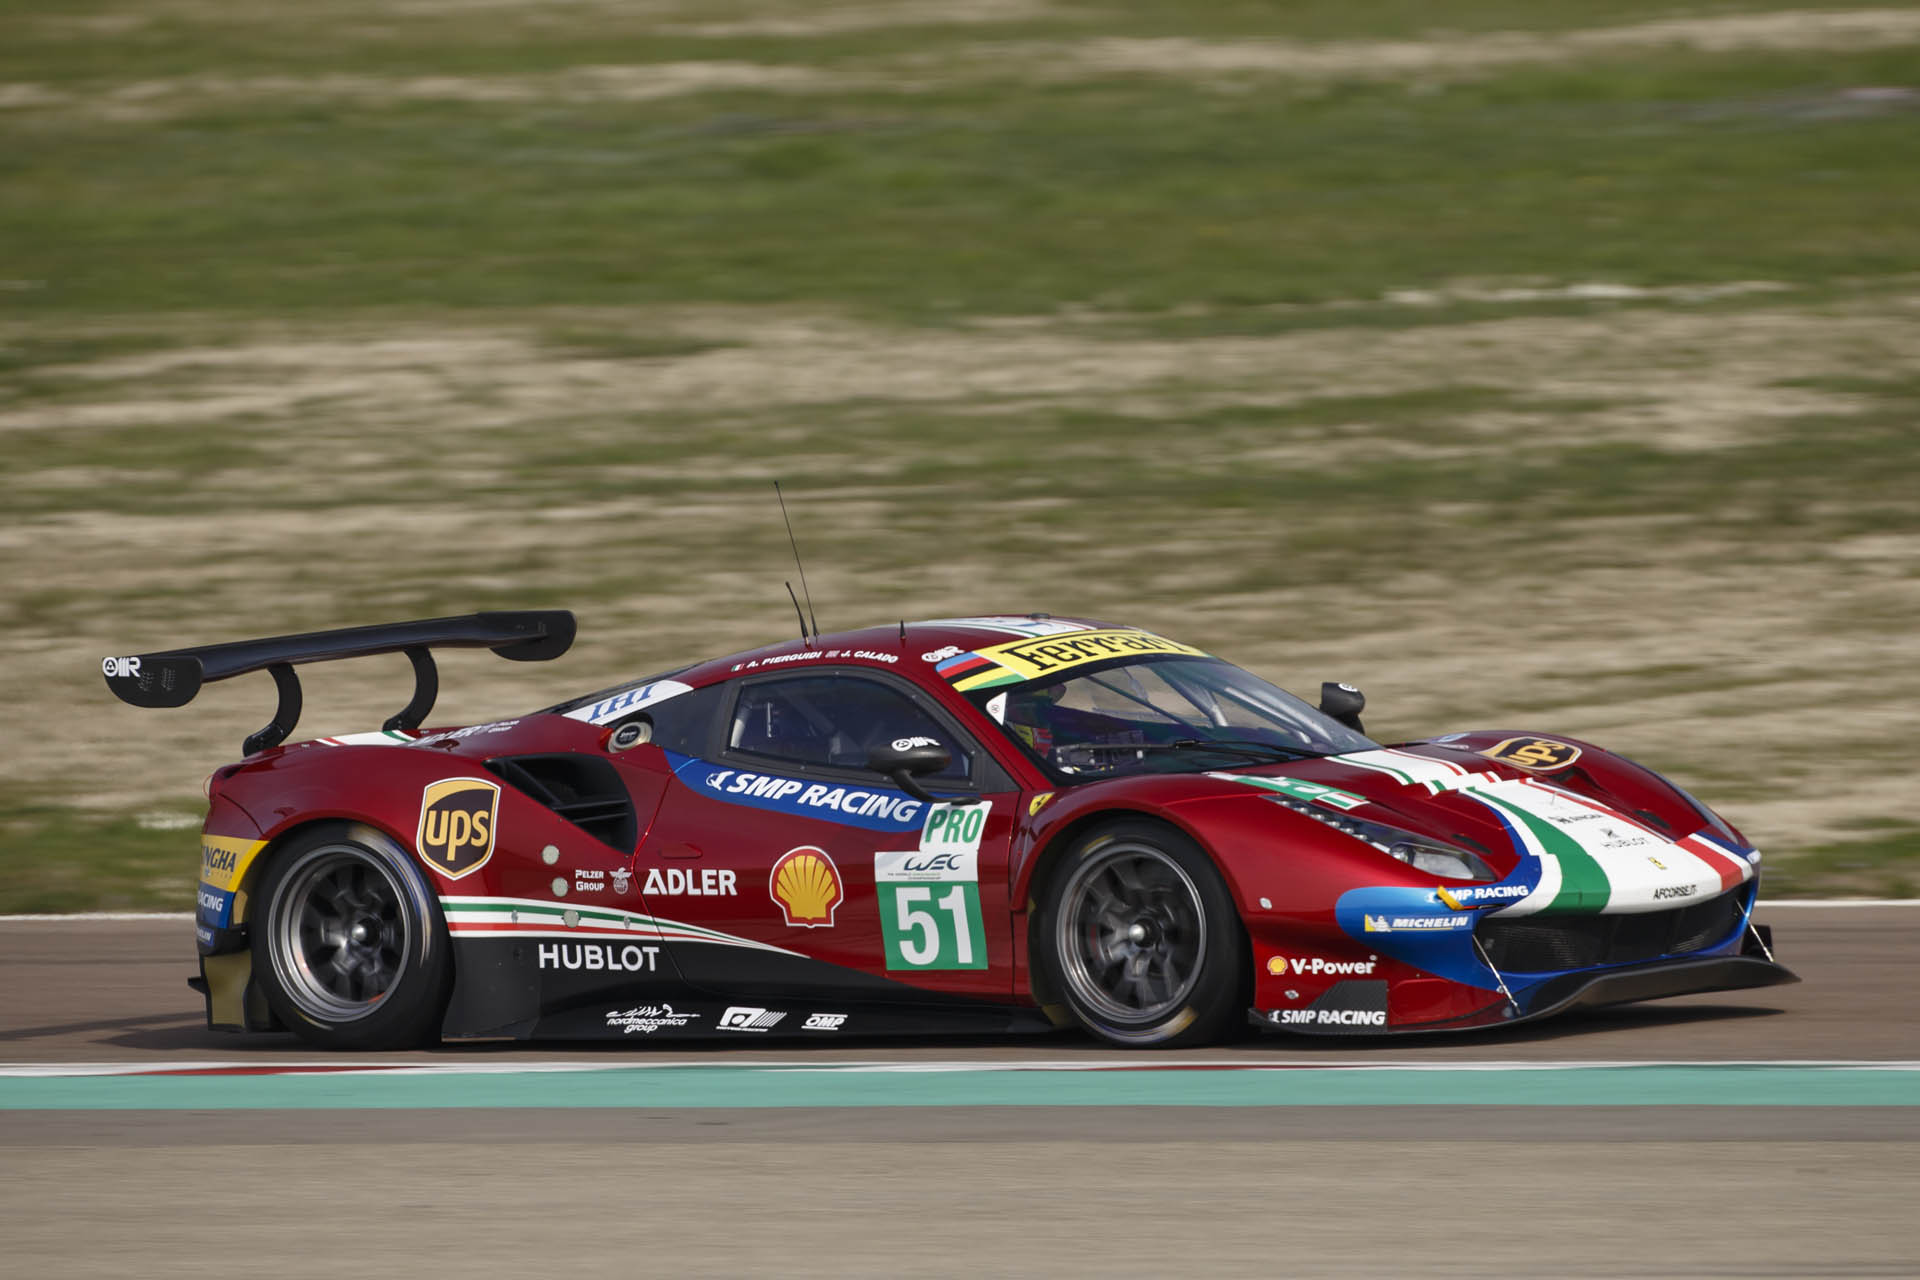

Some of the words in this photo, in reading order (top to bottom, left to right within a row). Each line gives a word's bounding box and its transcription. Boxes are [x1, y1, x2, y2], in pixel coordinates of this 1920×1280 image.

[747, 660, 760, 669] A.
[761, 650, 822, 666] PIERGUIDI
[840, 650, 851, 658] J.
[853, 650, 899, 663] CALADO
[998, 632, 1192, 671] Ferrari
[1508, 741, 1567, 766] ups
[726, 773, 803, 800] SMP
[797, 784, 922, 822] RACING
[425, 809, 490, 861] ups
[925, 808, 983, 844] PRO
[904, 854, 964, 871] WEC
[643, 868, 738, 896] ADLER
[1447, 888, 1473, 901] MP
[1474, 885, 1529, 900] RACING
[895, 886, 973, 965] 51
[1392, 916, 1469, 928] MICHELIN
[538, 943, 660, 971] HUBLOT
[1290, 958, 1376, 975] V-Power
[607, 1016, 688, 1026] nordmeccanica
[805, 1016, 846, 1027] OMP
[1281, 1010, 1317, 1023] SMP
[1317, 1010, 1386, 1025] RACING
[624, 1025, 659, 1034] group
